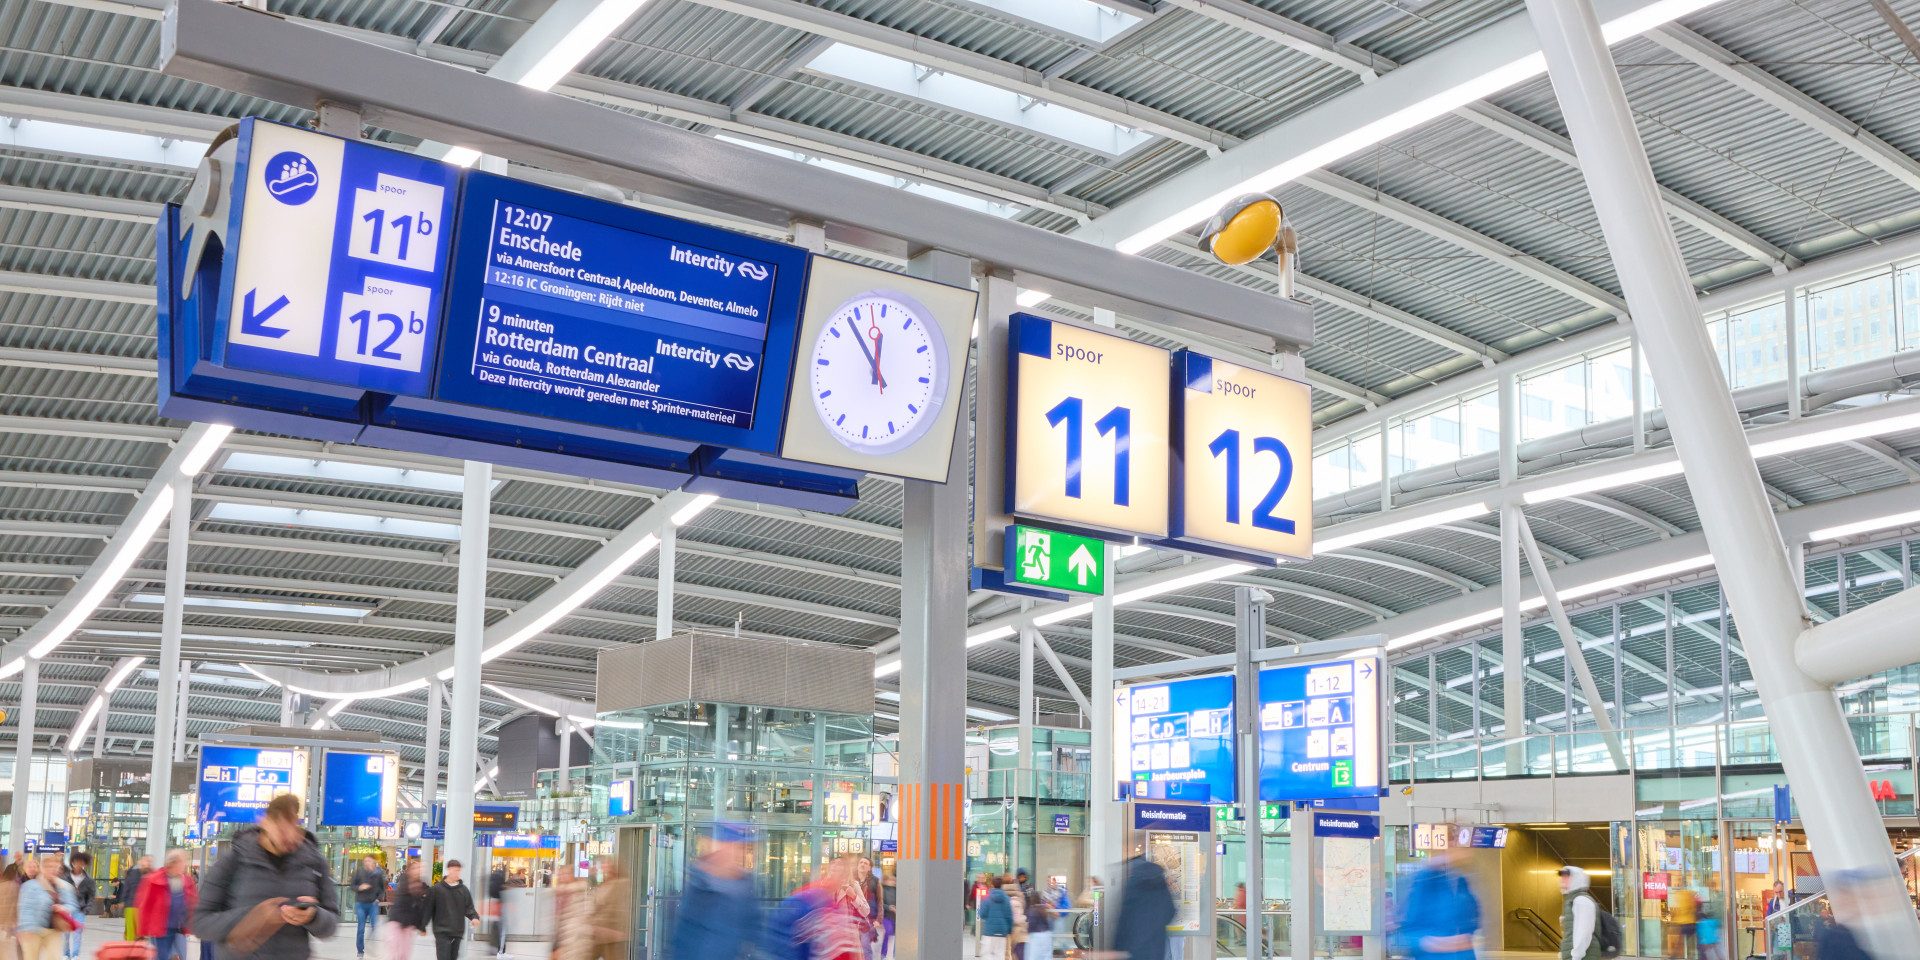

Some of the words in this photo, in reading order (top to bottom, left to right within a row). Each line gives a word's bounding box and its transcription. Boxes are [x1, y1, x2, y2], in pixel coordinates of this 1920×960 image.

[379, 183, 407, 196] spoor
[504, 206, 552, 232] 12:07
[500, 228, 582, 262] Enschede
[670, 245, 734, 276] Intercity
[367, 284, 394, 296] spoor
[494, 271, 524, 288] 12:16
[527, 278, 537, 290] IC
[540, 281, 597, 304] Groningen:
[599, 293, 623, 312] Rijdt
[625, 299, 645, 313] niet
[496, 252, 513, 266] via
[514, 255, 576, 279] Amersfoort
[577, 268, 621, 290] Centraal,
[623, 279, 678, 303] Apeldoorn,
[680, 291, 724, 312] Deventer,
[726, 301, 759, 318] Almelo
[489, 305, 501, 323] 9
[503, 314, 554, 334] minuten
[485, 327, 578, 360] Rotterdam
[584, 345, 654, 374] Centraal
[656, 339, 720, 368] Intercity
[1056, 343, 1104, 365] spoor
[482, 351, 500, 365] via
[503, 355, 543, 374] Gouda,
[545, 362, 604, 384] Rotterdam
[606, 373, 660, 393] Alexander
[1216, 377, 1256, 399] spoor
[479, 370, 506, 385] Deze
[508, 374, 552, 394] Intercity
[554, 383, 585, 399] wordt
[587, 389, 628, 407] gereden
[630, 396, 650, 410] met
[651, 399, 735, 424] Sprinter-materieel
[1044, 396, 1131, 507] 11
[1207, 428, 1296, 536] 12
[1283, 710, 1293, 727] B
[1330, 706, 1343, 723] A
[1210, 717, 1222, 733] H
[1151, 769, 1206, 781] Jaarbeursplein
[1291, 761, 1330, 773] Centrum
[221, 771, 231, 781] H
[829, 804, 848, 821] 14
[858, 805, 875, 822] 15
[1141, 810, 1187, 820] Reisinformatie
[362, 826, 375, 837] 18
[384, 826, 396, 837] 19
[1319, 819, 1359, 829] Reisinformatie
[1419, 833, 1430, 847] 14
[1434, 834, 1446, 847] 15
[1644, 882, 1667, 890] HEMA
